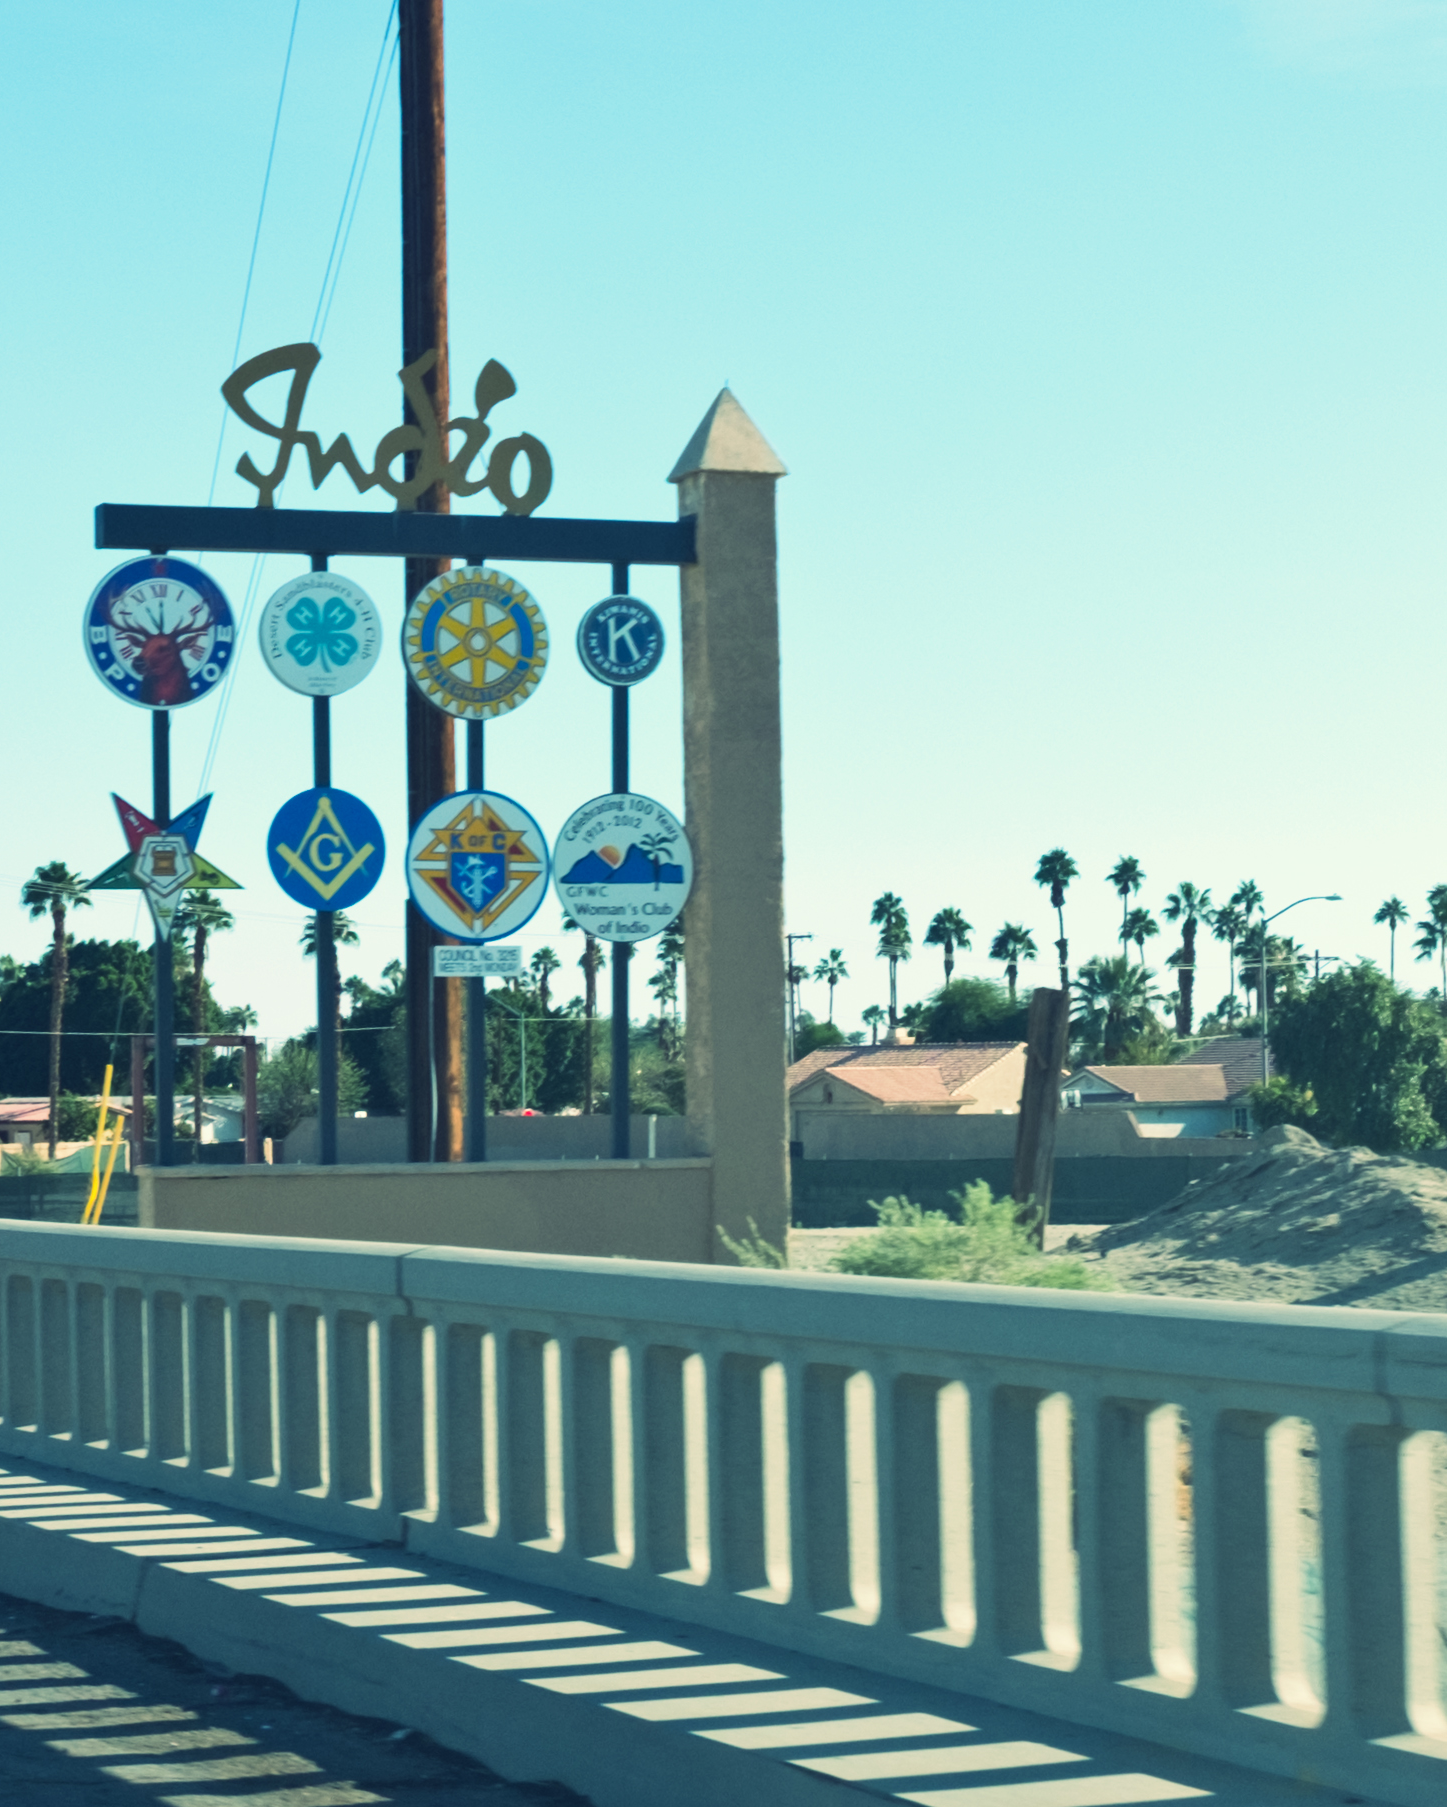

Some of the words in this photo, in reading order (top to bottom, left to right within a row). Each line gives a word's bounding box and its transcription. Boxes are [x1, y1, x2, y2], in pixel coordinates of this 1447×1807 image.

[221, 341, 555, 512] Indio
[450, 583, 505, 601] ROTARY
[596, 604, 651, 624] KIWANIS
[607, 616, 642, 664] K
[588, 632, 658, 675] INTERNATIONAL
[426, 661, 526, 702] INTERNATIONAL
[563, 800, 625, 842] Celebrating
[629, 798, 654, 816] 100
[656, 810, 680, 841] Years
[450, 832, 464, 850] K
[491, 832, 506, 850] C
[309, 832, 344, 872] G
[565, 885, 609, 898] GFWC
[574, 902, 639, 916] Woman's
[641, 902, 674, 916] Club
[597, 920, 614, 934] of
[615, 920, 650, 934] Indio
[438, 949, 478, 962] COUNCIL
